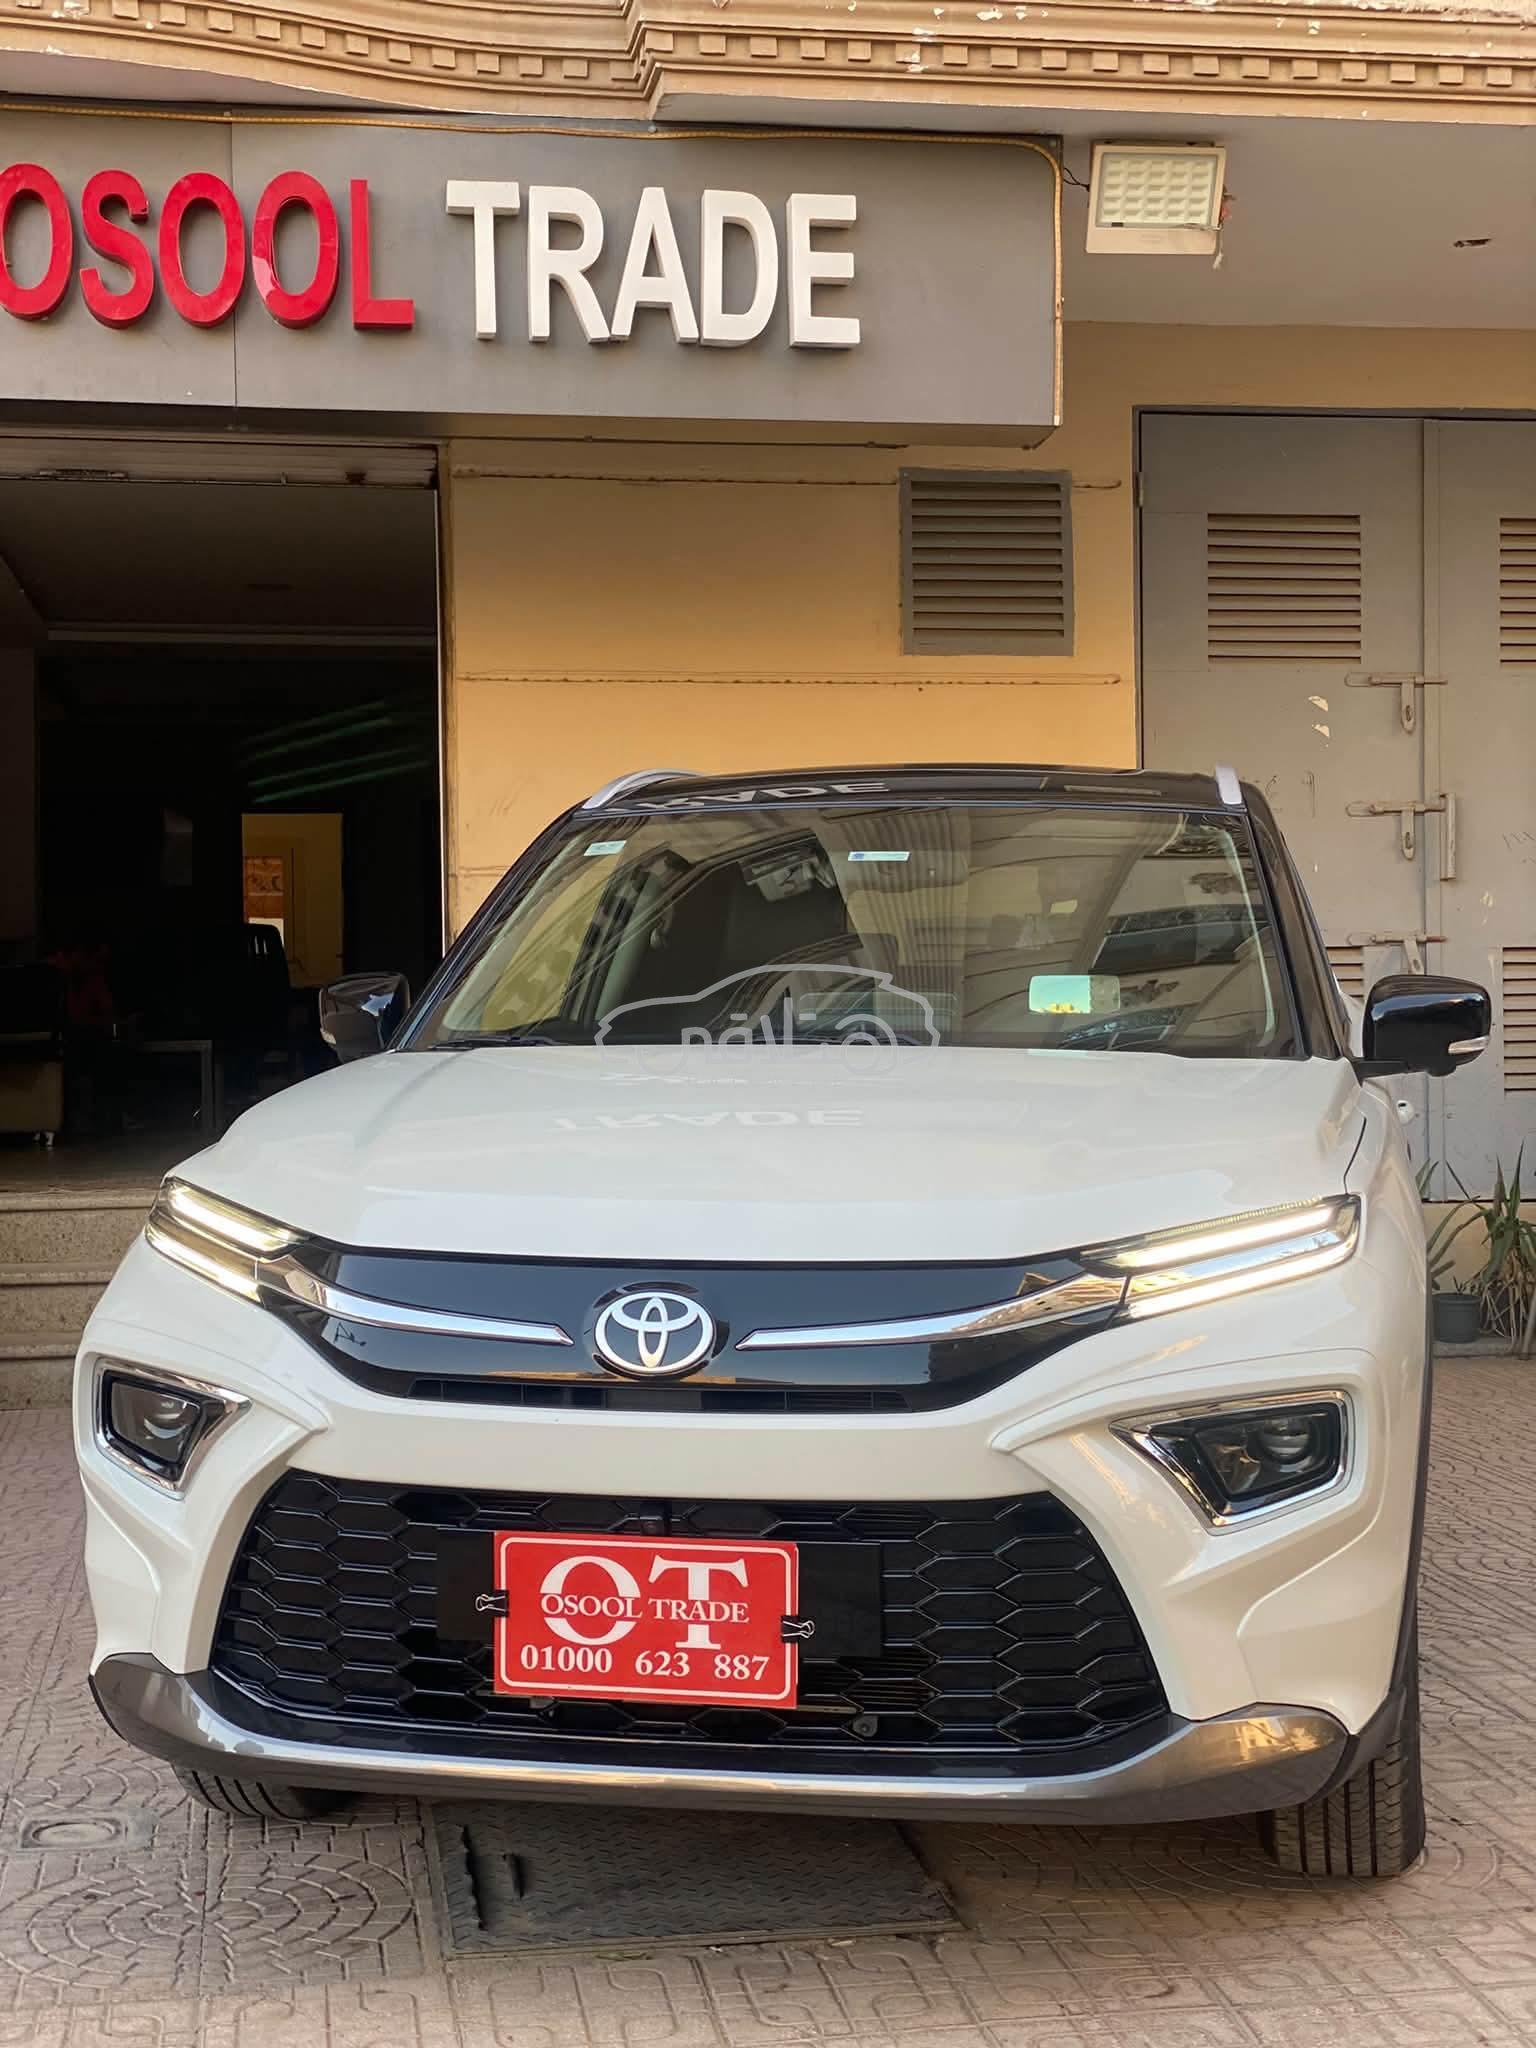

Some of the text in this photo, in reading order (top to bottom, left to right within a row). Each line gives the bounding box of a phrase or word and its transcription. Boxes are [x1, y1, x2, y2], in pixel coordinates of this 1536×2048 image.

[0, 163, 861, 348] OSOOL TRADE
[540, 1594, 750, 1624] OSOOL TRADE
[520, 1644, 770, 1681] 01000 623 887
